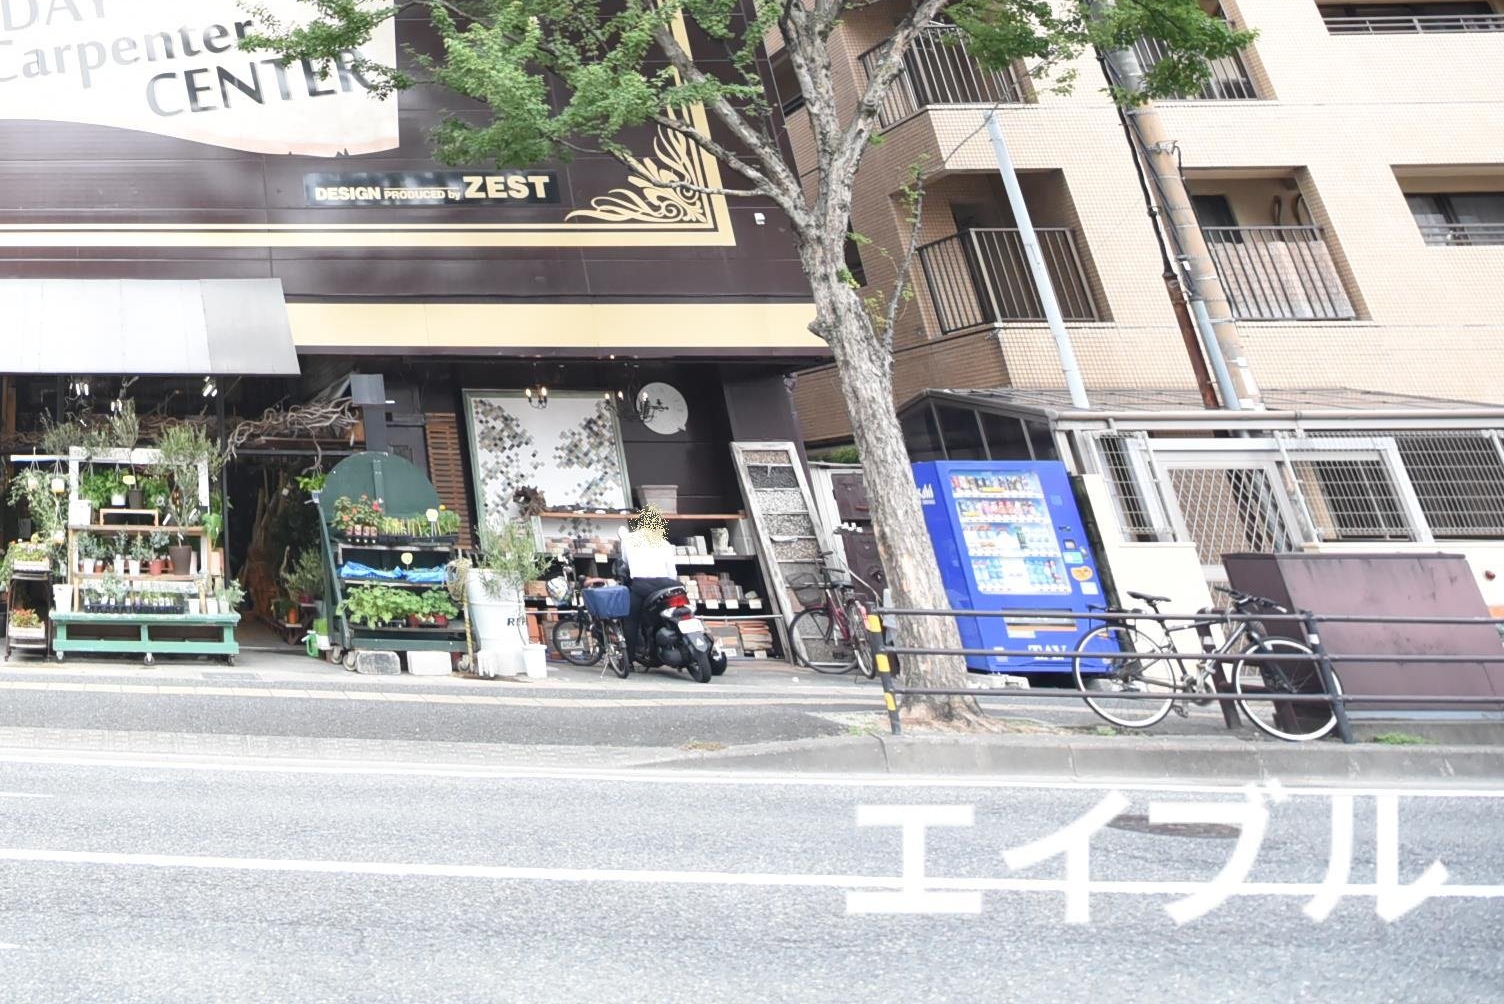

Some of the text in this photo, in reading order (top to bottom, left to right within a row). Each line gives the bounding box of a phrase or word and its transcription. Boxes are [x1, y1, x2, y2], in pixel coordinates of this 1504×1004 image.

[315, 175, 549, 201] DESIGN PRODUCED by ZEST
